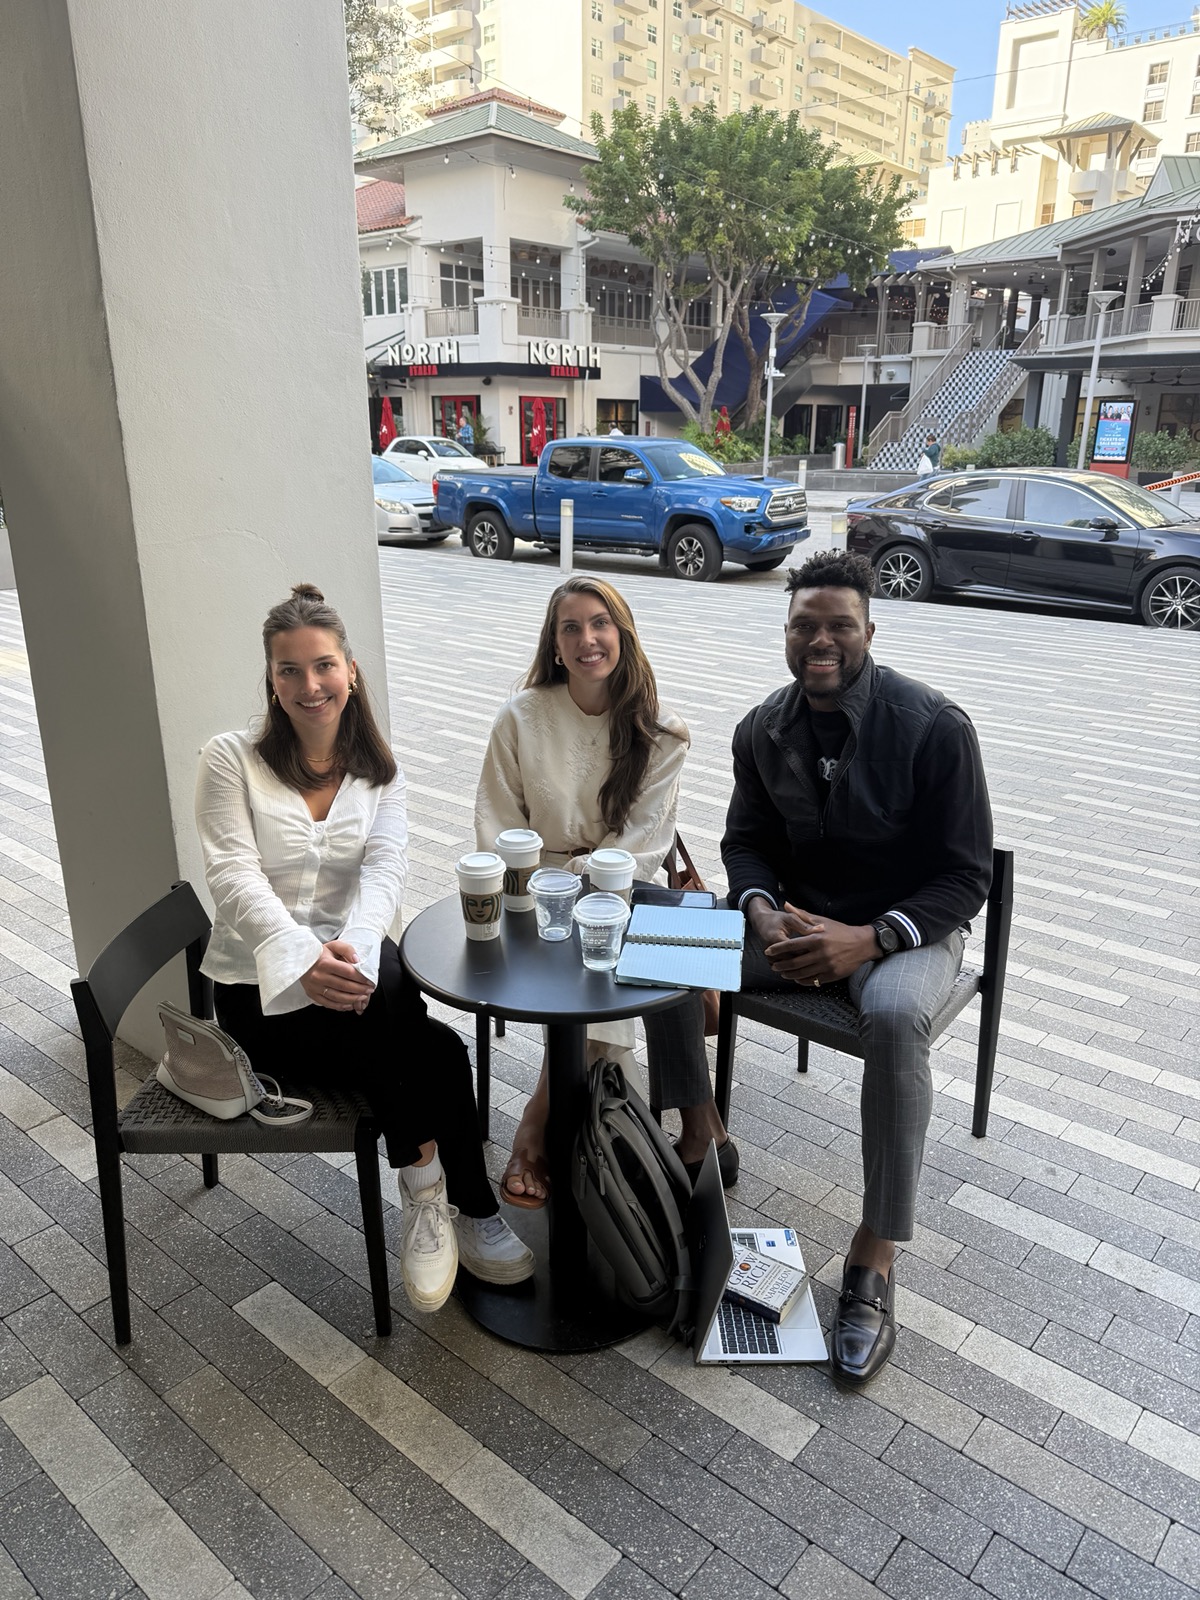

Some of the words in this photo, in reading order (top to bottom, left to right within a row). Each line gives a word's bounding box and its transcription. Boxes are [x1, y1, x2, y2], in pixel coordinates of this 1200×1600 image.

[387, 340, 460, 366] NORTH
[528, 341, 600, 368] NORTH
[409, 364, 438, 377] ITALIA
[550, 365, 580, 378] ITALIA
[728, 1253, 758, 1285] GROW
[741, 1261, 770, 1290] RICH
[763, 1269, 792, 1301] NAPOLEON
[777, 1281, 794, 1296] HILL
